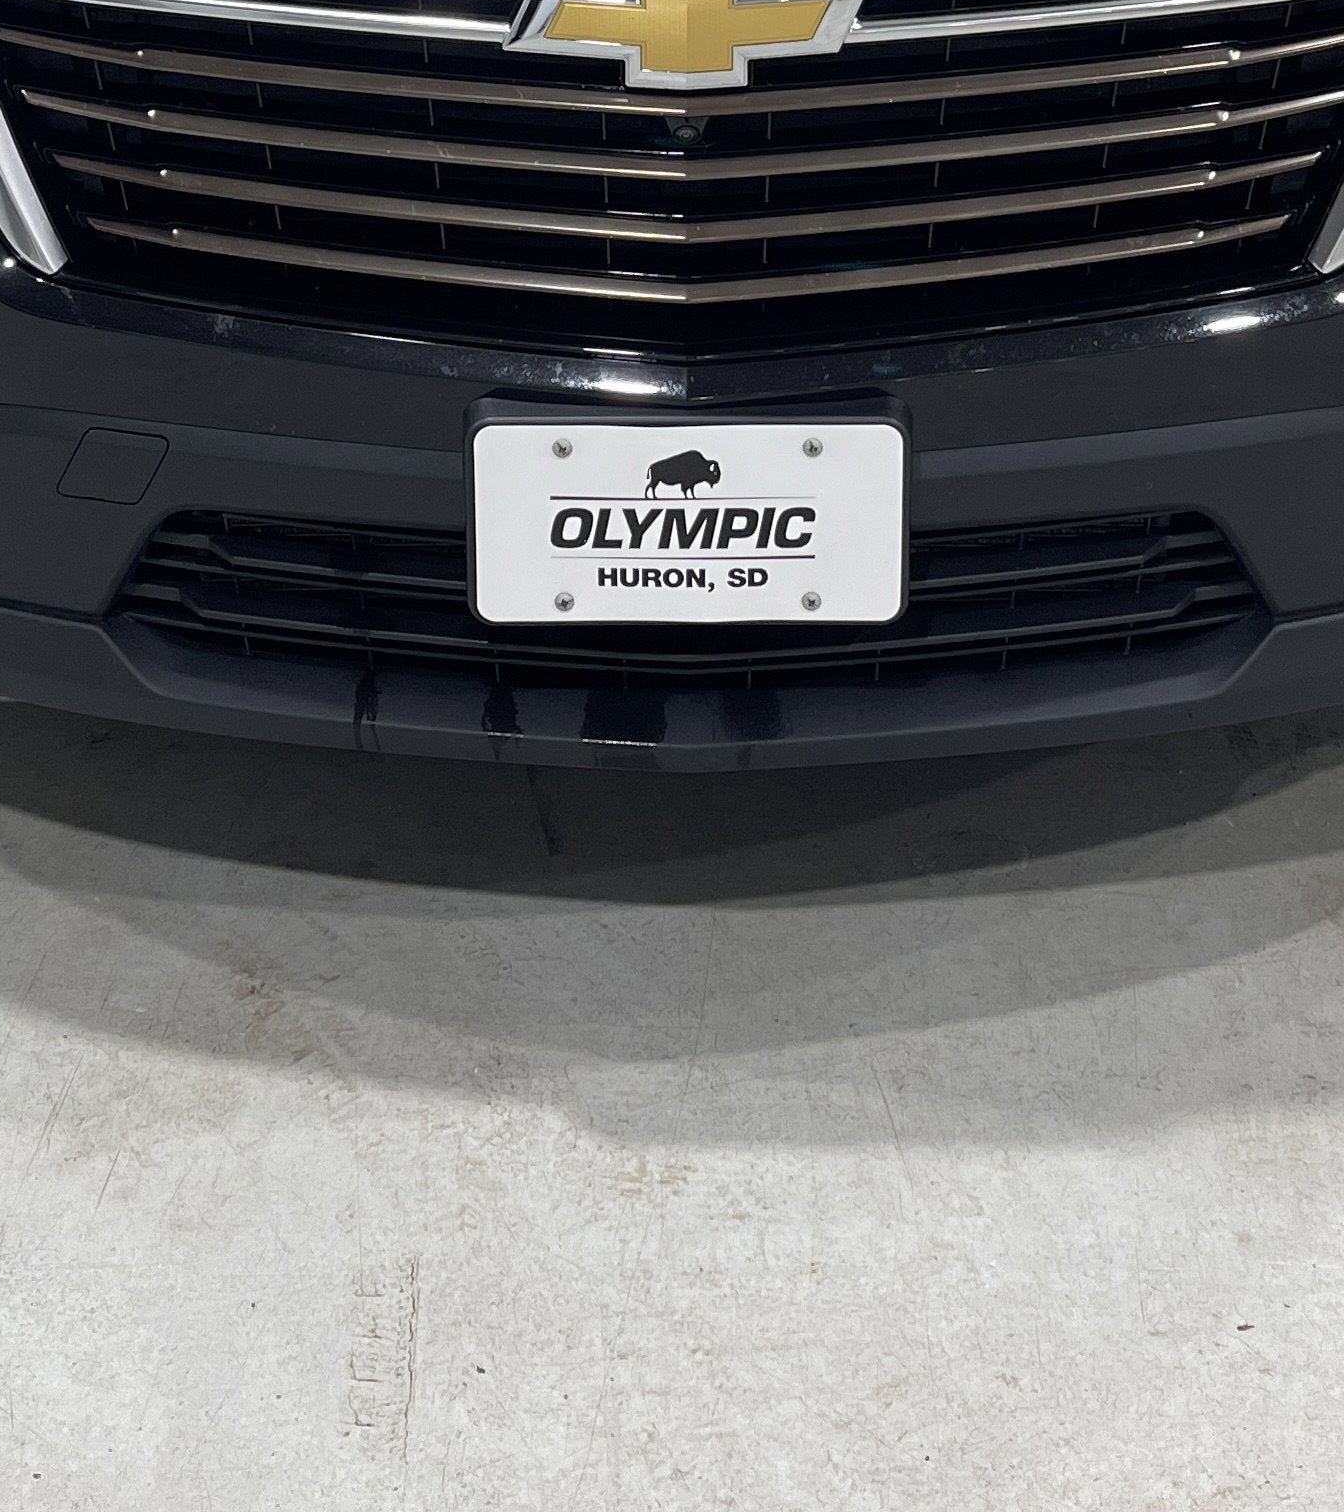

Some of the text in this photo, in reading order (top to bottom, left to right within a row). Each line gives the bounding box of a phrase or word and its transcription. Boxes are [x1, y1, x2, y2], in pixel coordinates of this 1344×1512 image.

[550, 507, 816, 549] OLYMPIC
[598, 567, 769, 592] HURON, SD
